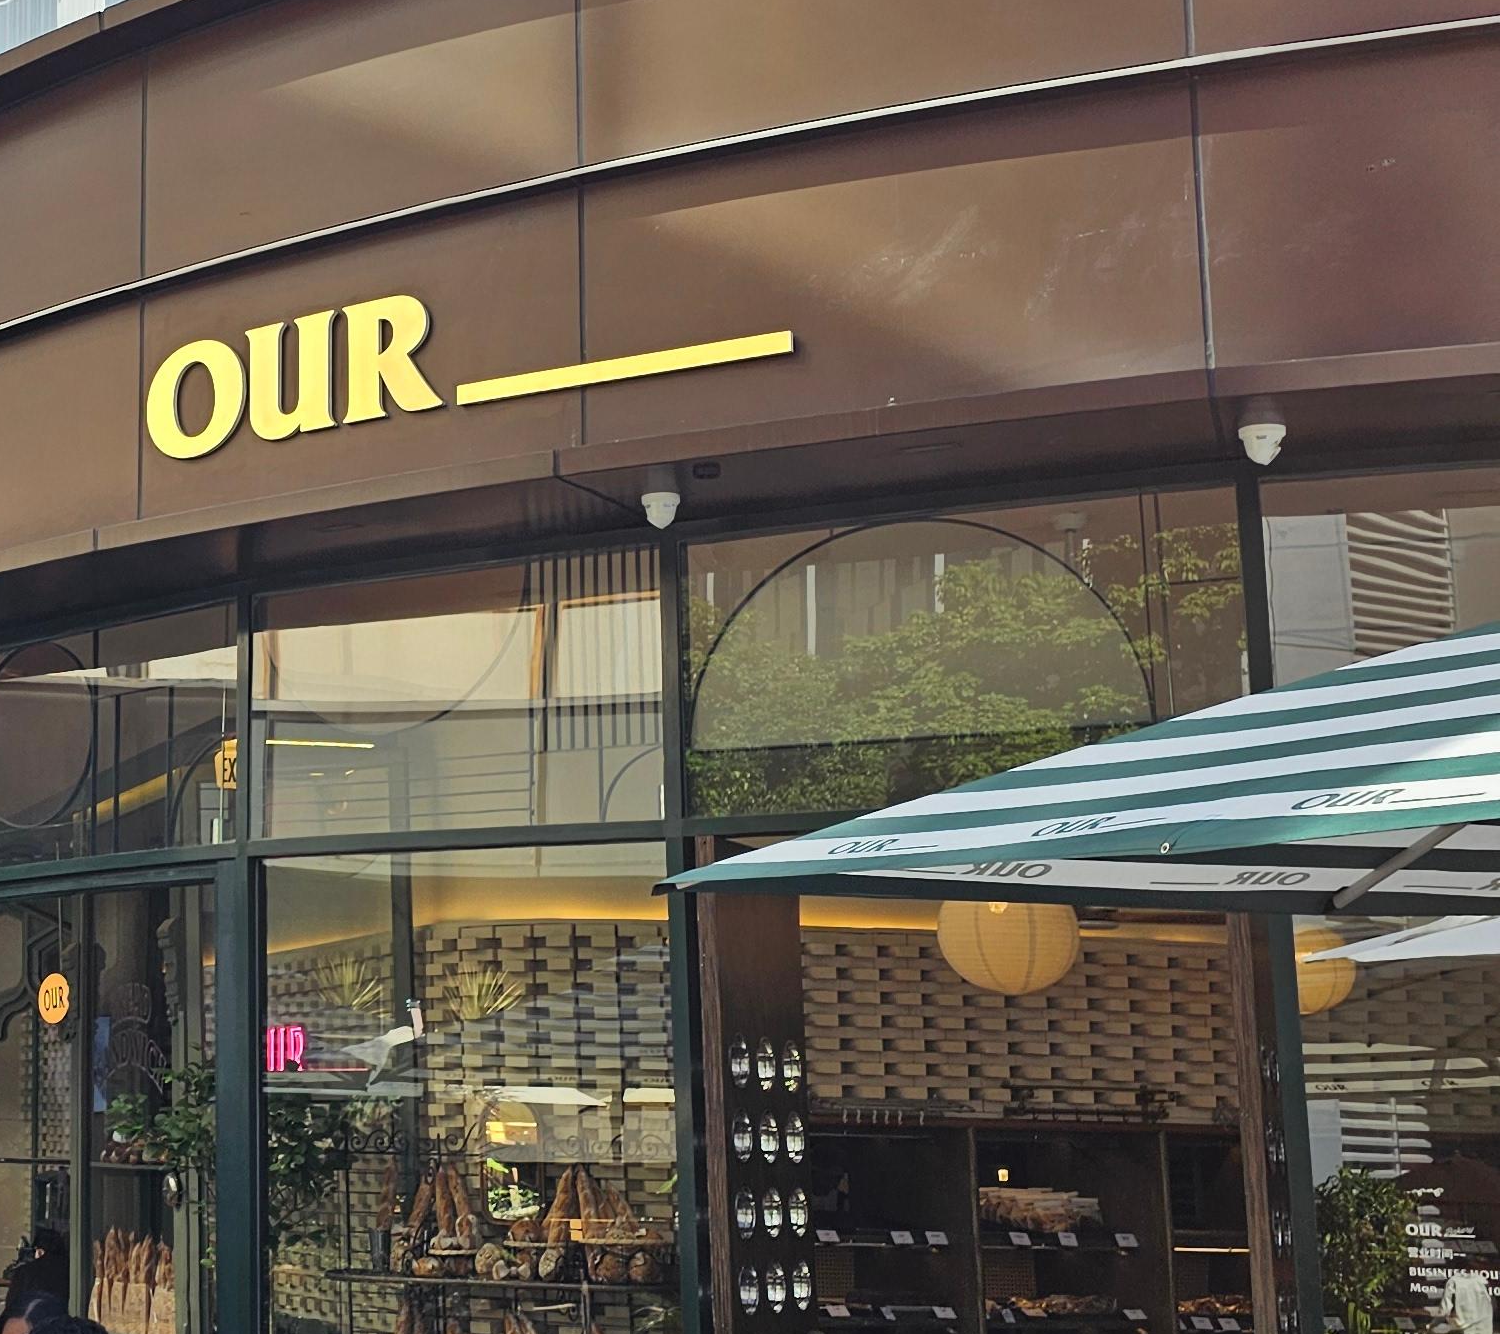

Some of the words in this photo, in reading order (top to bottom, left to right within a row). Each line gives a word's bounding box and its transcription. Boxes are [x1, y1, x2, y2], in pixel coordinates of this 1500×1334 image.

[146, 294, 446, 460] OUR
[1291, 789, 1406, 811] OUR
[1032, 816, 1116, 837] OUR
[828, 838, 899, 855] OUR
[43, 986, 66, 1012] OUR
[1405, 1223, 1442, 1237] OUR
